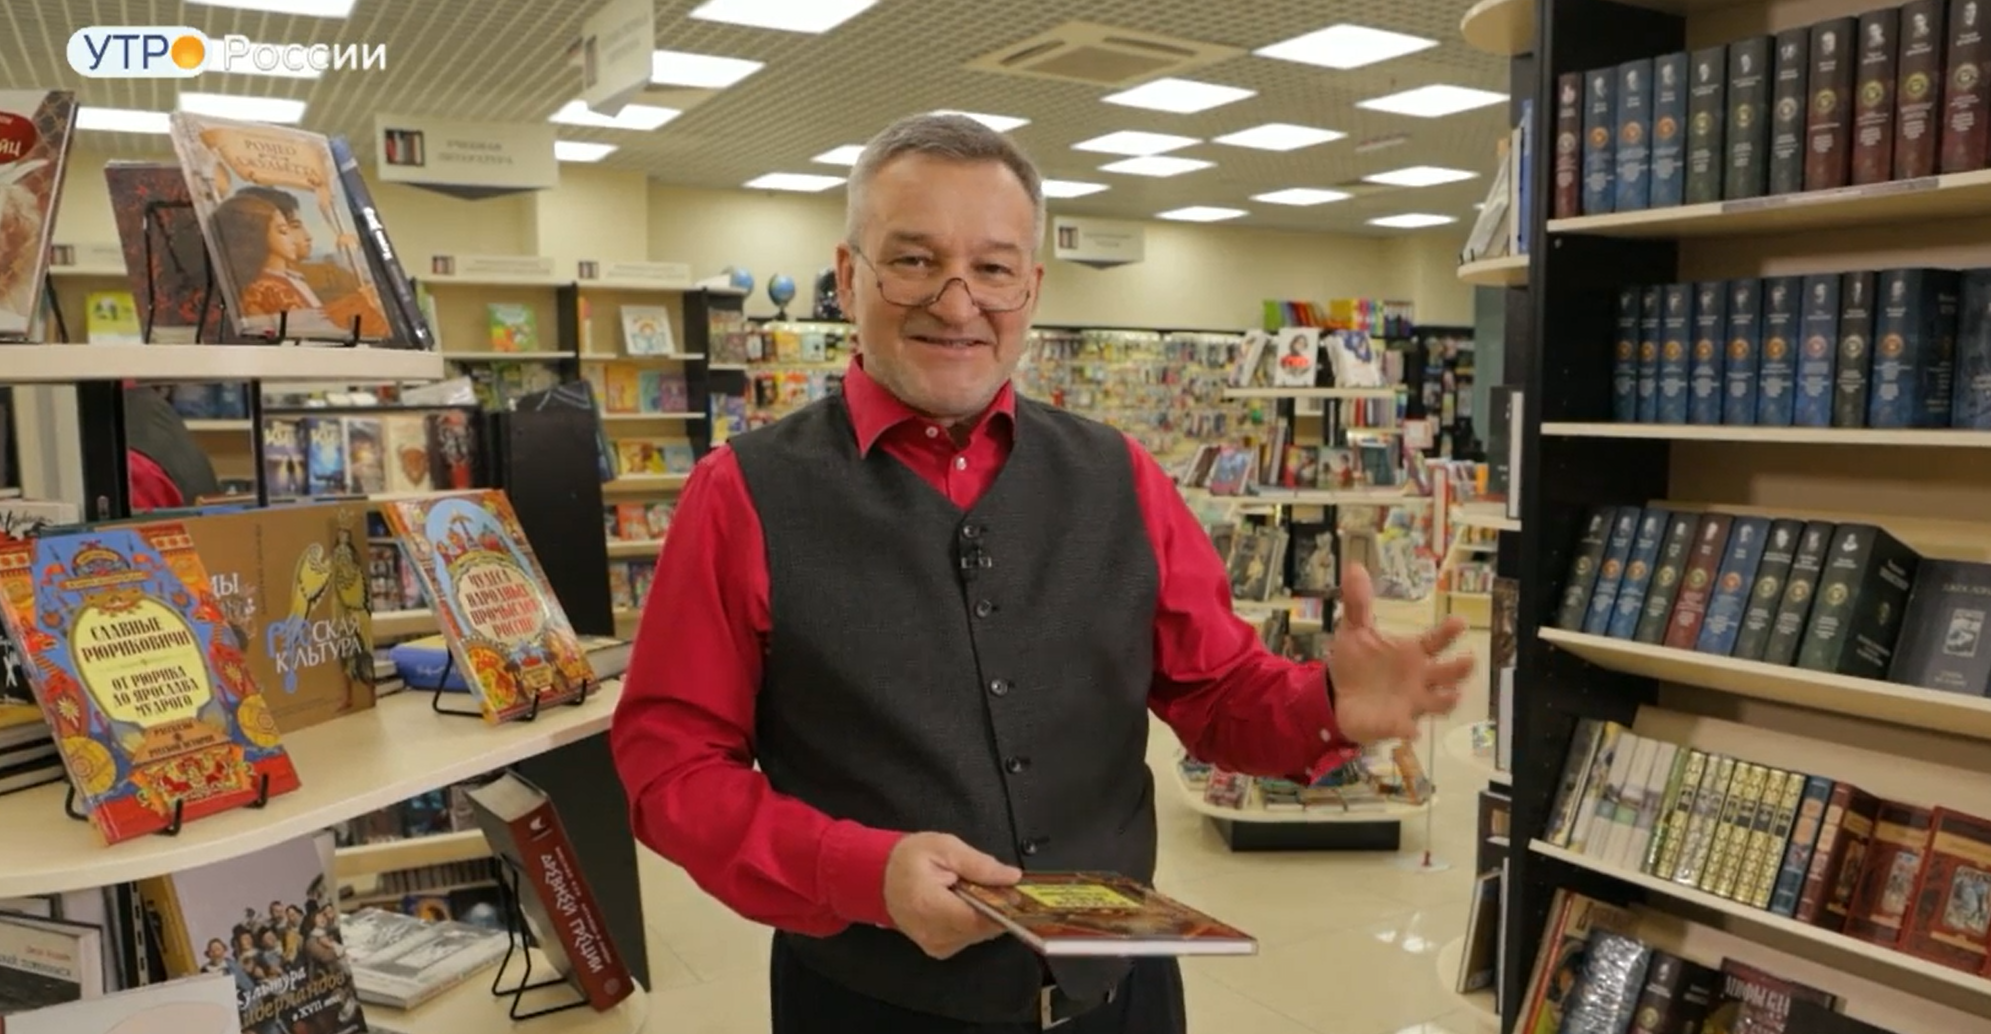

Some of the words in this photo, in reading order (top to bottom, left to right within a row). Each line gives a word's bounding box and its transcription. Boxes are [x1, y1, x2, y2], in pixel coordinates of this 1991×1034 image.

[90, 615, 163, 641] СЛАВНЫЕ
[81, 629, 191, 663] РЮРИКОВИЧИ
[111, 677, 129, 691] ОТ
[130, 665, 187, 688] РЮРИКА
[113, 691, 131, 708] ДО
[132, 678, 199, 704] ЯРОСЛАВА
[135, 696, 193, 718] МУДРОГО
[240, 969, 346, 1028] идерландов
